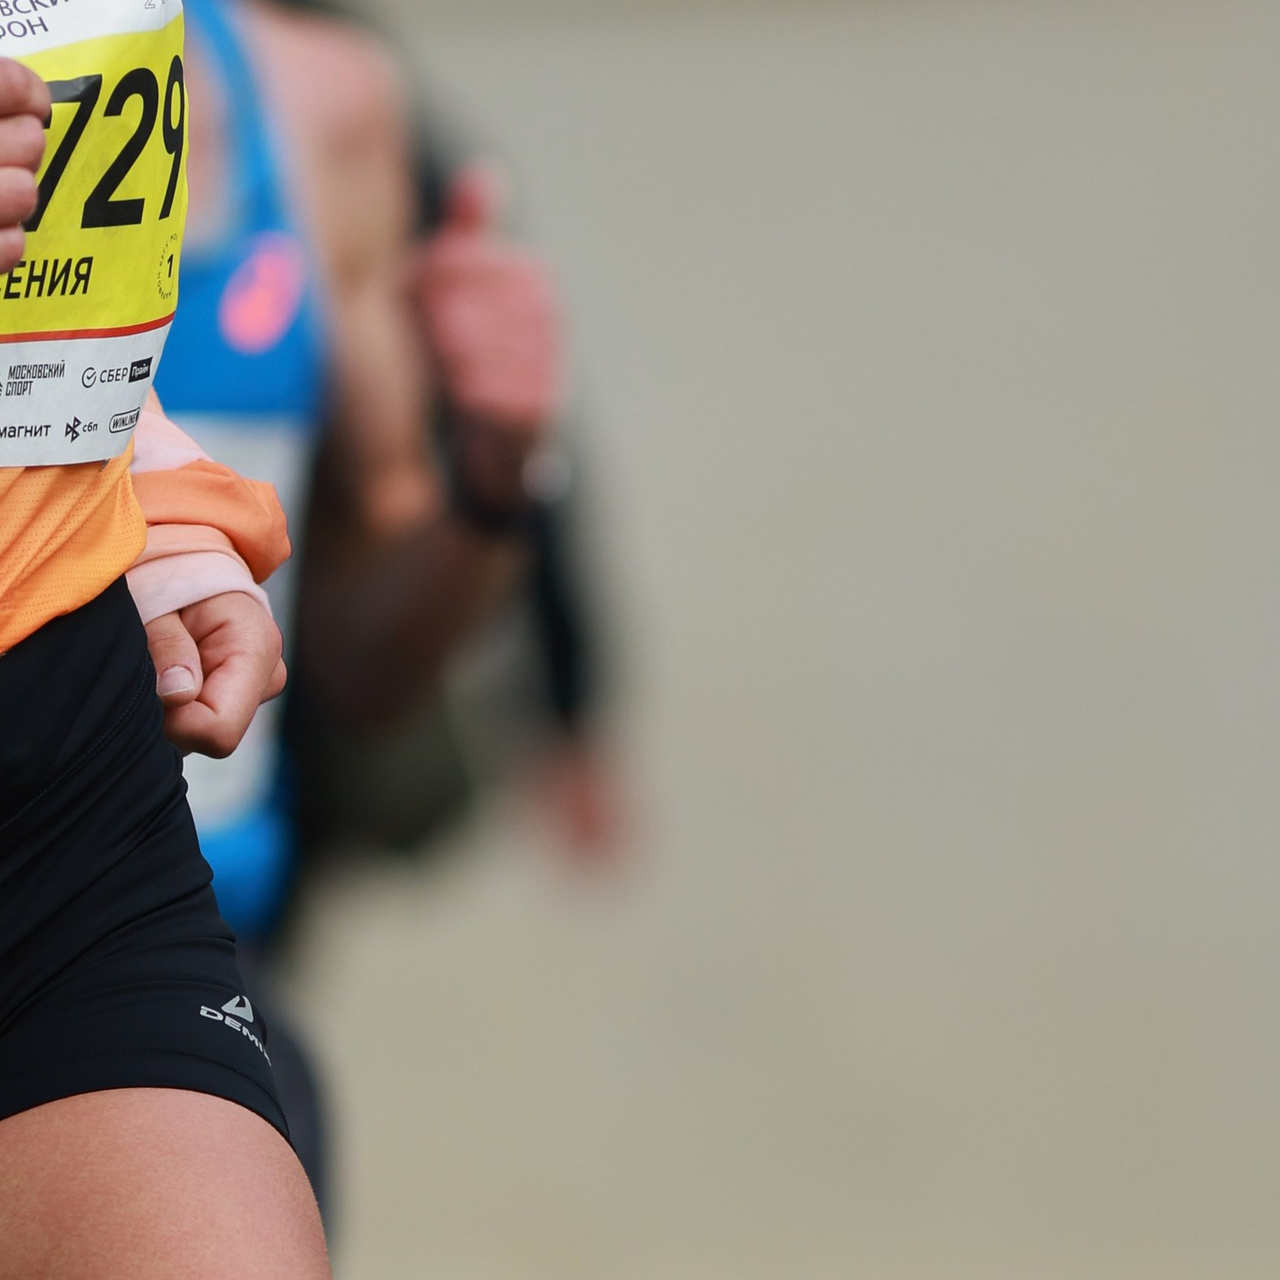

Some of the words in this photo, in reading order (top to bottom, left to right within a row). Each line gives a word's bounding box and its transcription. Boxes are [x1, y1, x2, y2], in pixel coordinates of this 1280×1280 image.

[167, 254, 174, 278] 1
[8, 359, 65, 380] МОСКОВСКИЙ
[99, 367, 128, 383] СБЕР
[5, 380, 34, 396] СПОРТ
[82, 421, 99, 433] сбп
